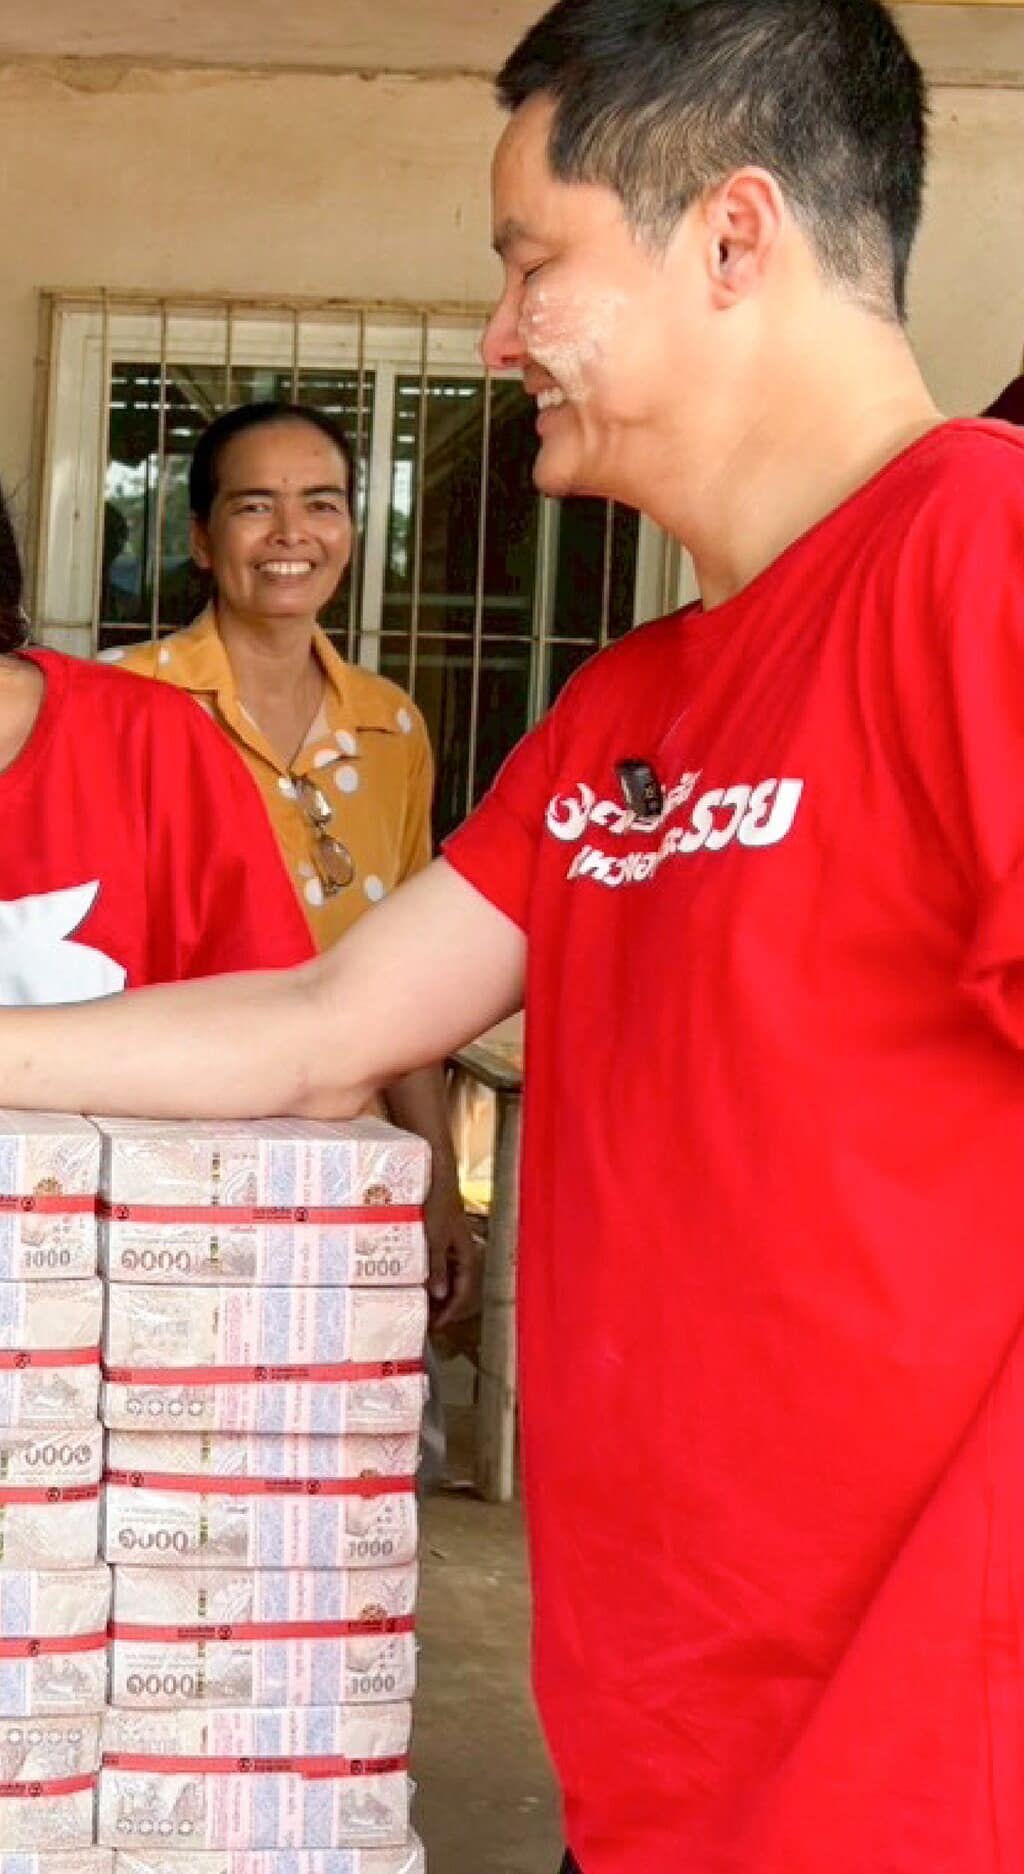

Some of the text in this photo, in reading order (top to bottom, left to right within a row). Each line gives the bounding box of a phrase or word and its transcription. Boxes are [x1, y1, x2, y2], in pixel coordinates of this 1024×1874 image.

[24, 1249, 71, 1268] 1000
[355, 1258, 401, 1278] 1000
[348, 1539, 394, 1558] 1000
[351, 1674, 396, 1694] 1000
